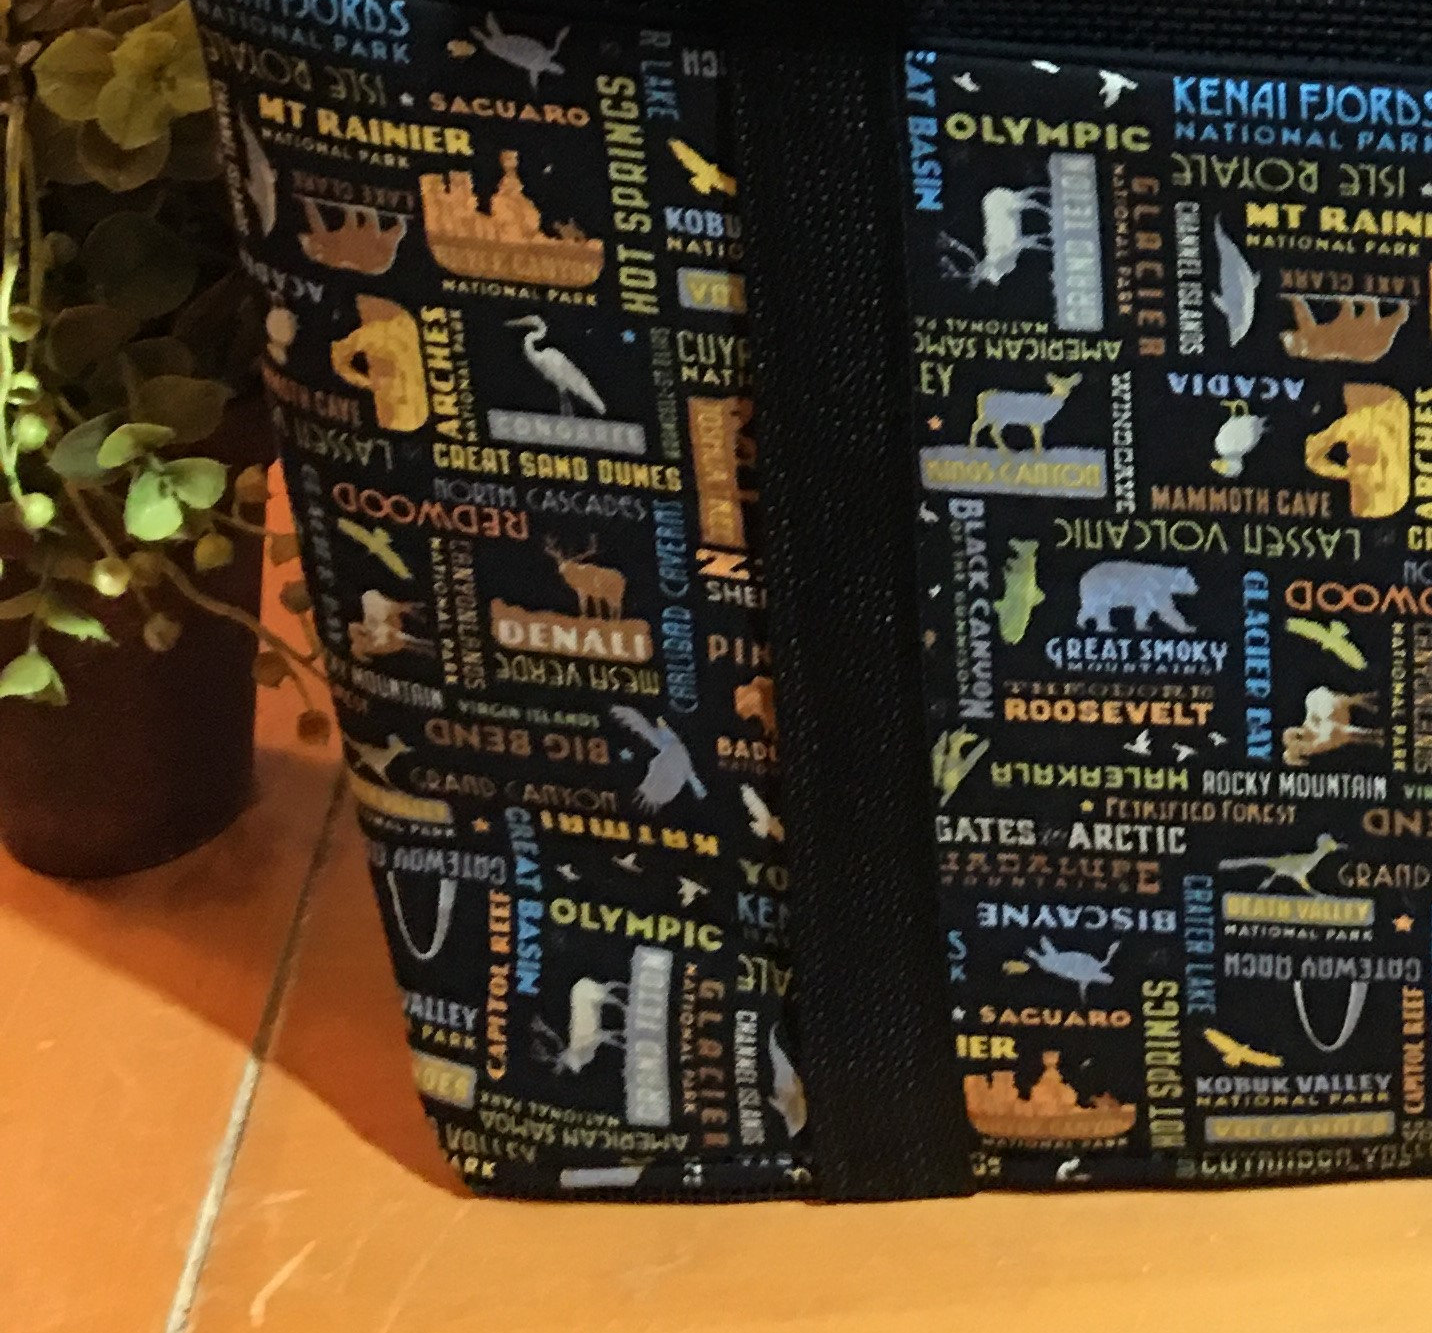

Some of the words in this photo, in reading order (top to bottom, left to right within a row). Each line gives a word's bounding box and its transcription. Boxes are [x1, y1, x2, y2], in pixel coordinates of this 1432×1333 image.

[1173, 77, 1288, 120] KENAI
[258, 92, 305, 128] MT
[317, 108, 475, 157] RAINIER
[945, 112, 1152, 152] OLYMPIC
[1175, 121, 1343, 152] NATIONAL
[357, 146, 411, 169] PARK
[909, 117, 943, 212] BASIN
[1340, 165, 1407, 198] ISLE
[1245, 202, 1307, 229] MT
[1245, 233, 1355, 256] NATIONAL
[1365, 239, 1421, 258] PARK
[441, 278, 541, 301] NATIONAL
[545, 288, 598, 308] PARK
[616, 243, 660, 317] HOT
[420, 304, 463, 442] ARCHES
[1167, 371, 1306, 401] ACADIA
[433, 443, 511, 474] GREAT
[520, 451, 589, 483] SAND
[598, 459, 682, 492] DUNES
[332, 482, 529, 541] REDWOOD
[1151, 484, 1270, 515] MAMMOTH
[1277, 489, 1332, 519] CAVE
[1054, 516, 1228, 555] VOLCANIC
[1243, 520, 1362, 561] LASSEN
[499, 617, 649, 661] DENALI
[1045, 635, 1130, 664] GREAT
[1138, 637, 1228, 672] SMOKY
[1003, 698, 1214, 727] ROOSEVELT
[423, 717, 533, 755] BEND
[543, 731, 610, 766] BIG
[989, 764, 1188, 793] HALEAKALA
[1201, 770, 1271, 796] ROCKY
[1278, 772, 1388, 801] MOUNTAIN
[539, 810, 721, 856] KATMAI
[936, 814, 1037, 846] GATES
[1068, 822, 1187, 856] ARCTIC
[549, 896, 725, 953] OLYMPIC
[976, 901, 1178, 933] BISCAYNE
[1224, 923, 1321, 943] NATIONAL
[1327, 928, 1374, 944] PARK
[514, 898, 543, 997] BASIN
[1196, 1094, 1320, 1107] NATIONAL
[1328, 1091, 1390, 1105] PARK
[1299, 1073, 1393, 1094] VALLEY
